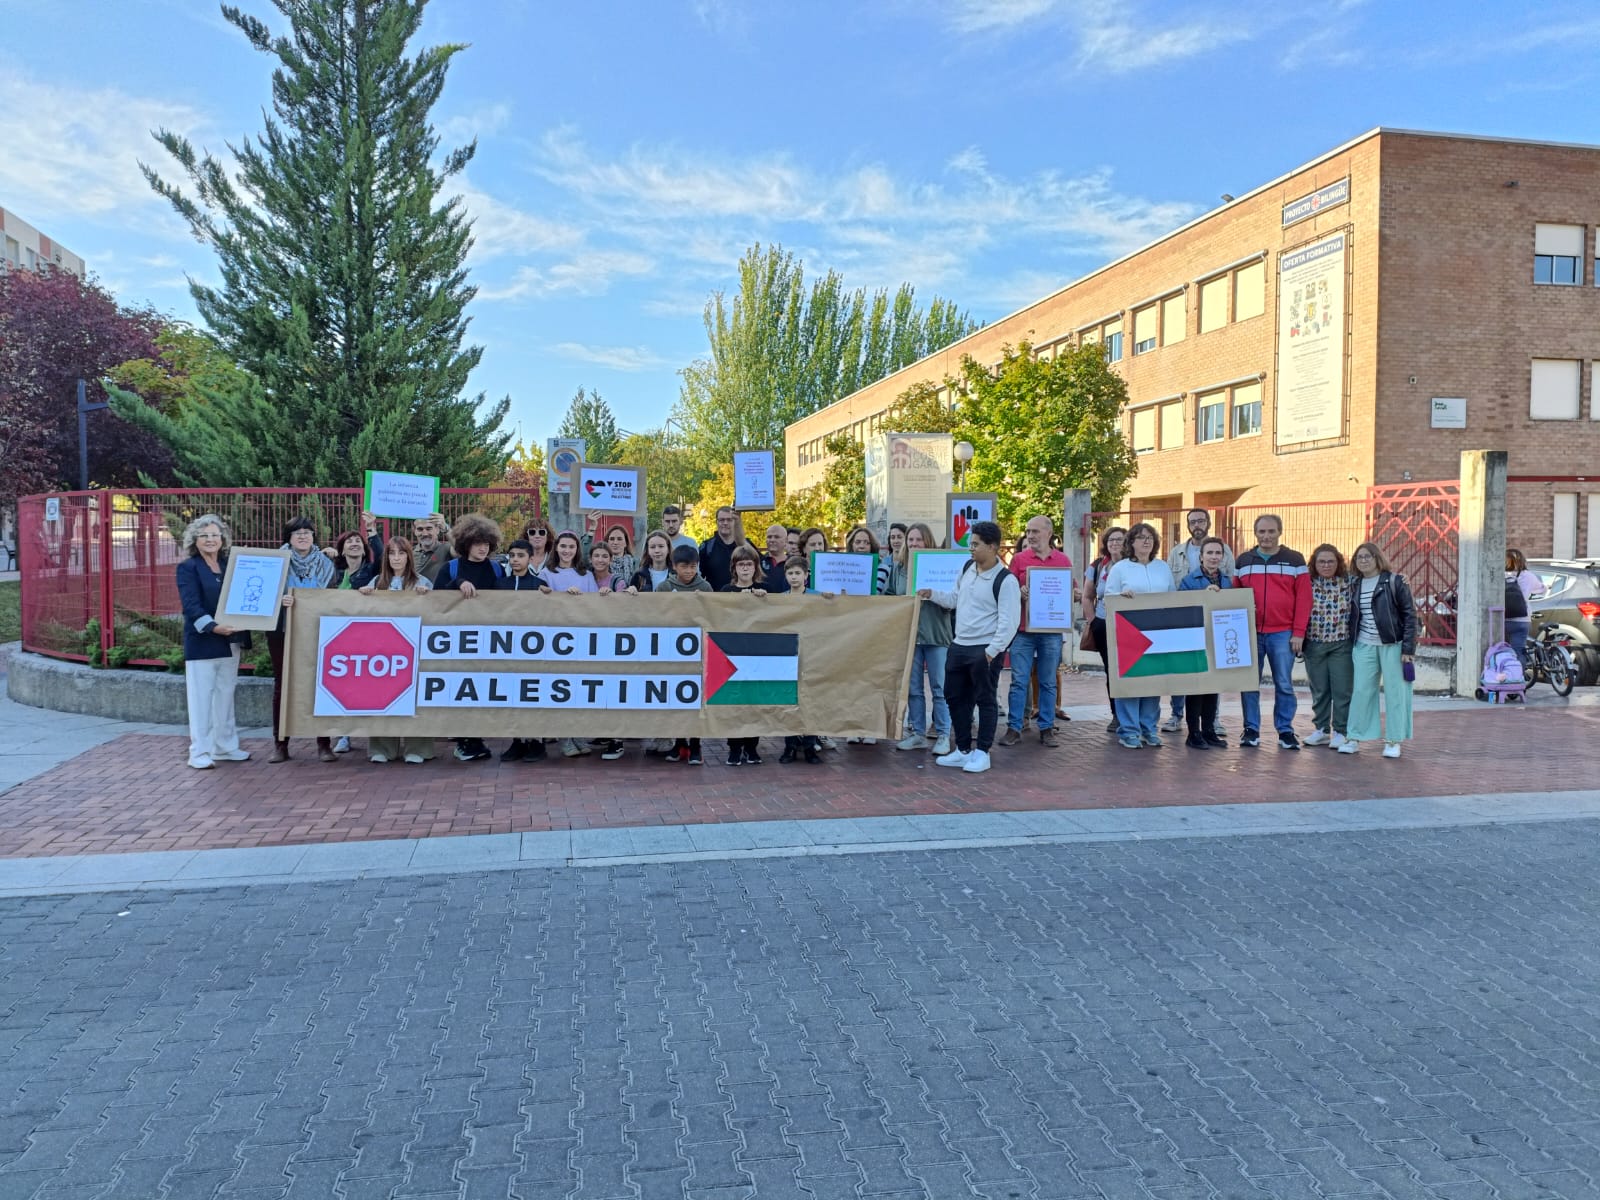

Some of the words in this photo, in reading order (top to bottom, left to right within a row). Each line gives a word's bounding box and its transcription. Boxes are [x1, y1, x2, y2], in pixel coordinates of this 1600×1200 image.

[1285, 202, 1311, 219] PROYECTO
[1320, 185, 1346, 204] BILINGÜE
[1283, 254, 1306, 269] OFERTA
[1306, 240, 1341, 260] FORMATIVA
[426, 630, 700, 657] GENOCIDIO
[328, 653, 409, 678] STOP
[424, 677, 700, 705] PALESTINO
